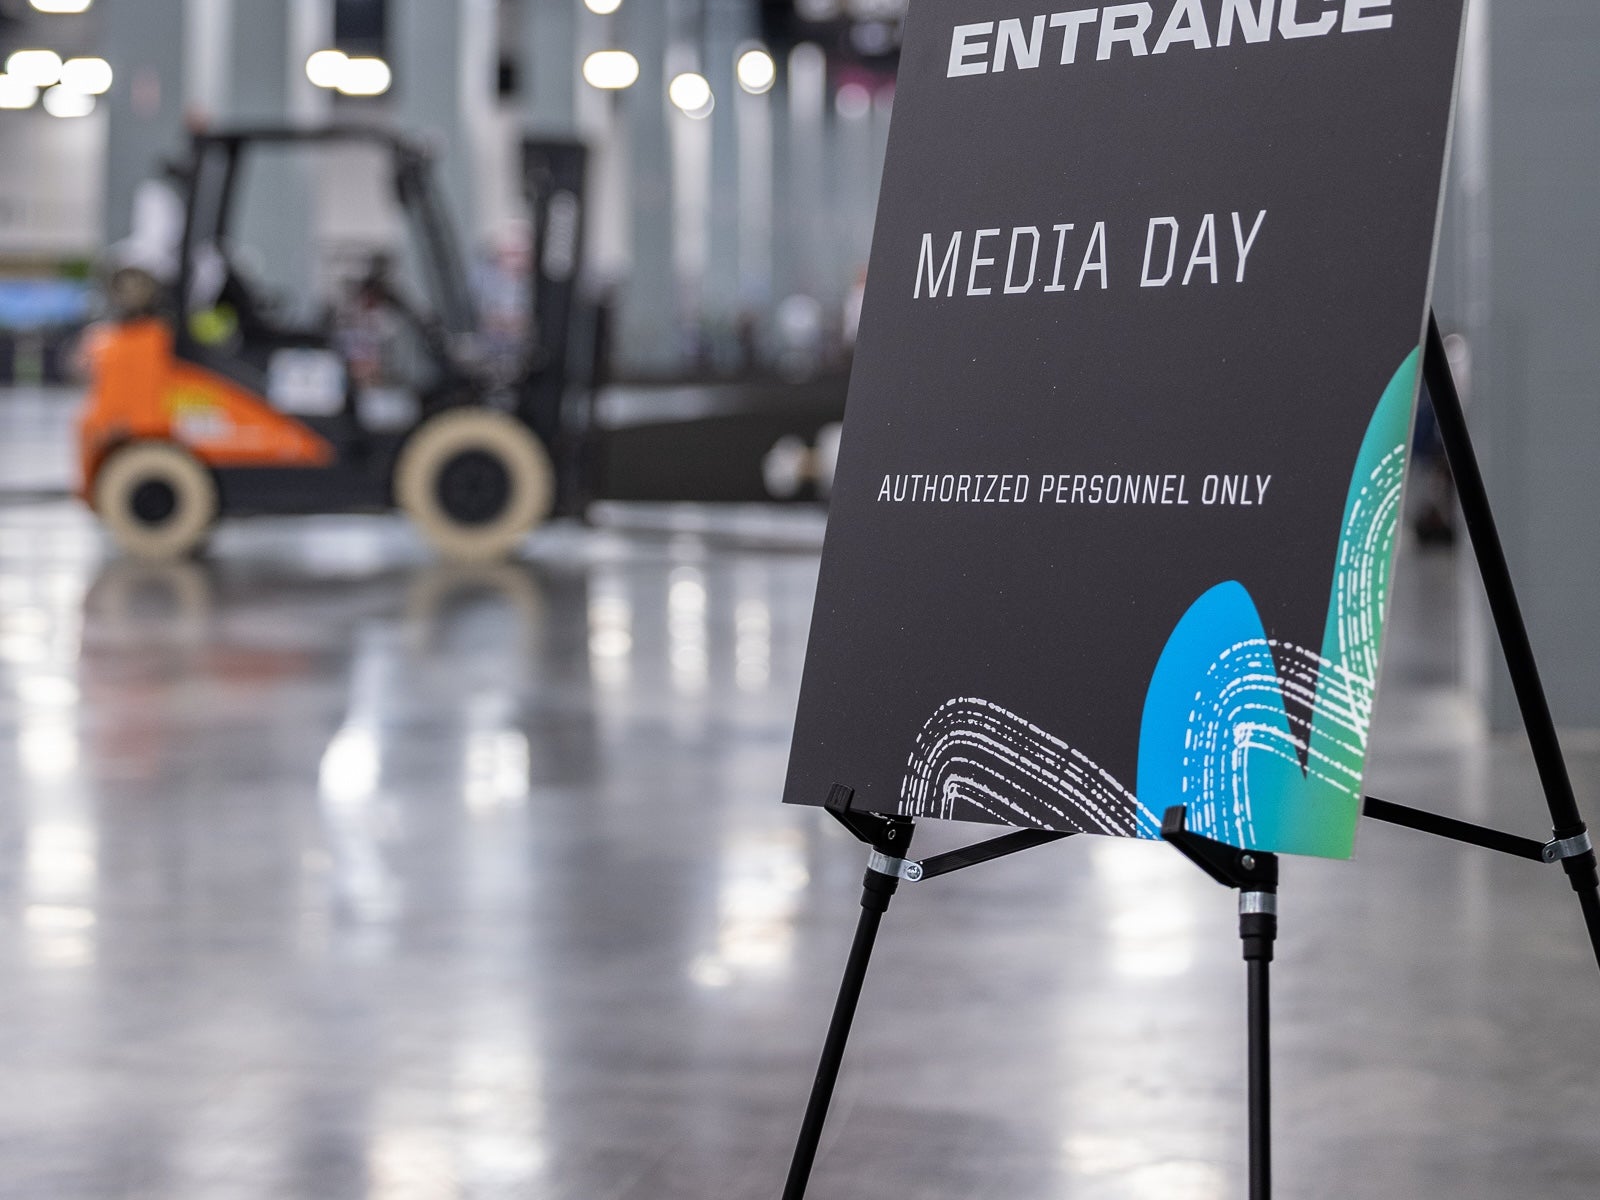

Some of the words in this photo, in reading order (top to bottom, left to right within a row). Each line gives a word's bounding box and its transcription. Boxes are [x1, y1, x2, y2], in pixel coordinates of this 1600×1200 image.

[913, 220, 1108, 299] MEDIA
[1139, 209, 1267, 288] DAY
[877, 474, 1029, 503] AUTHORIZED
[1039, 474, 1190, 504] PERSONNEL
[1201, 474, 1271, 505] ONLY
